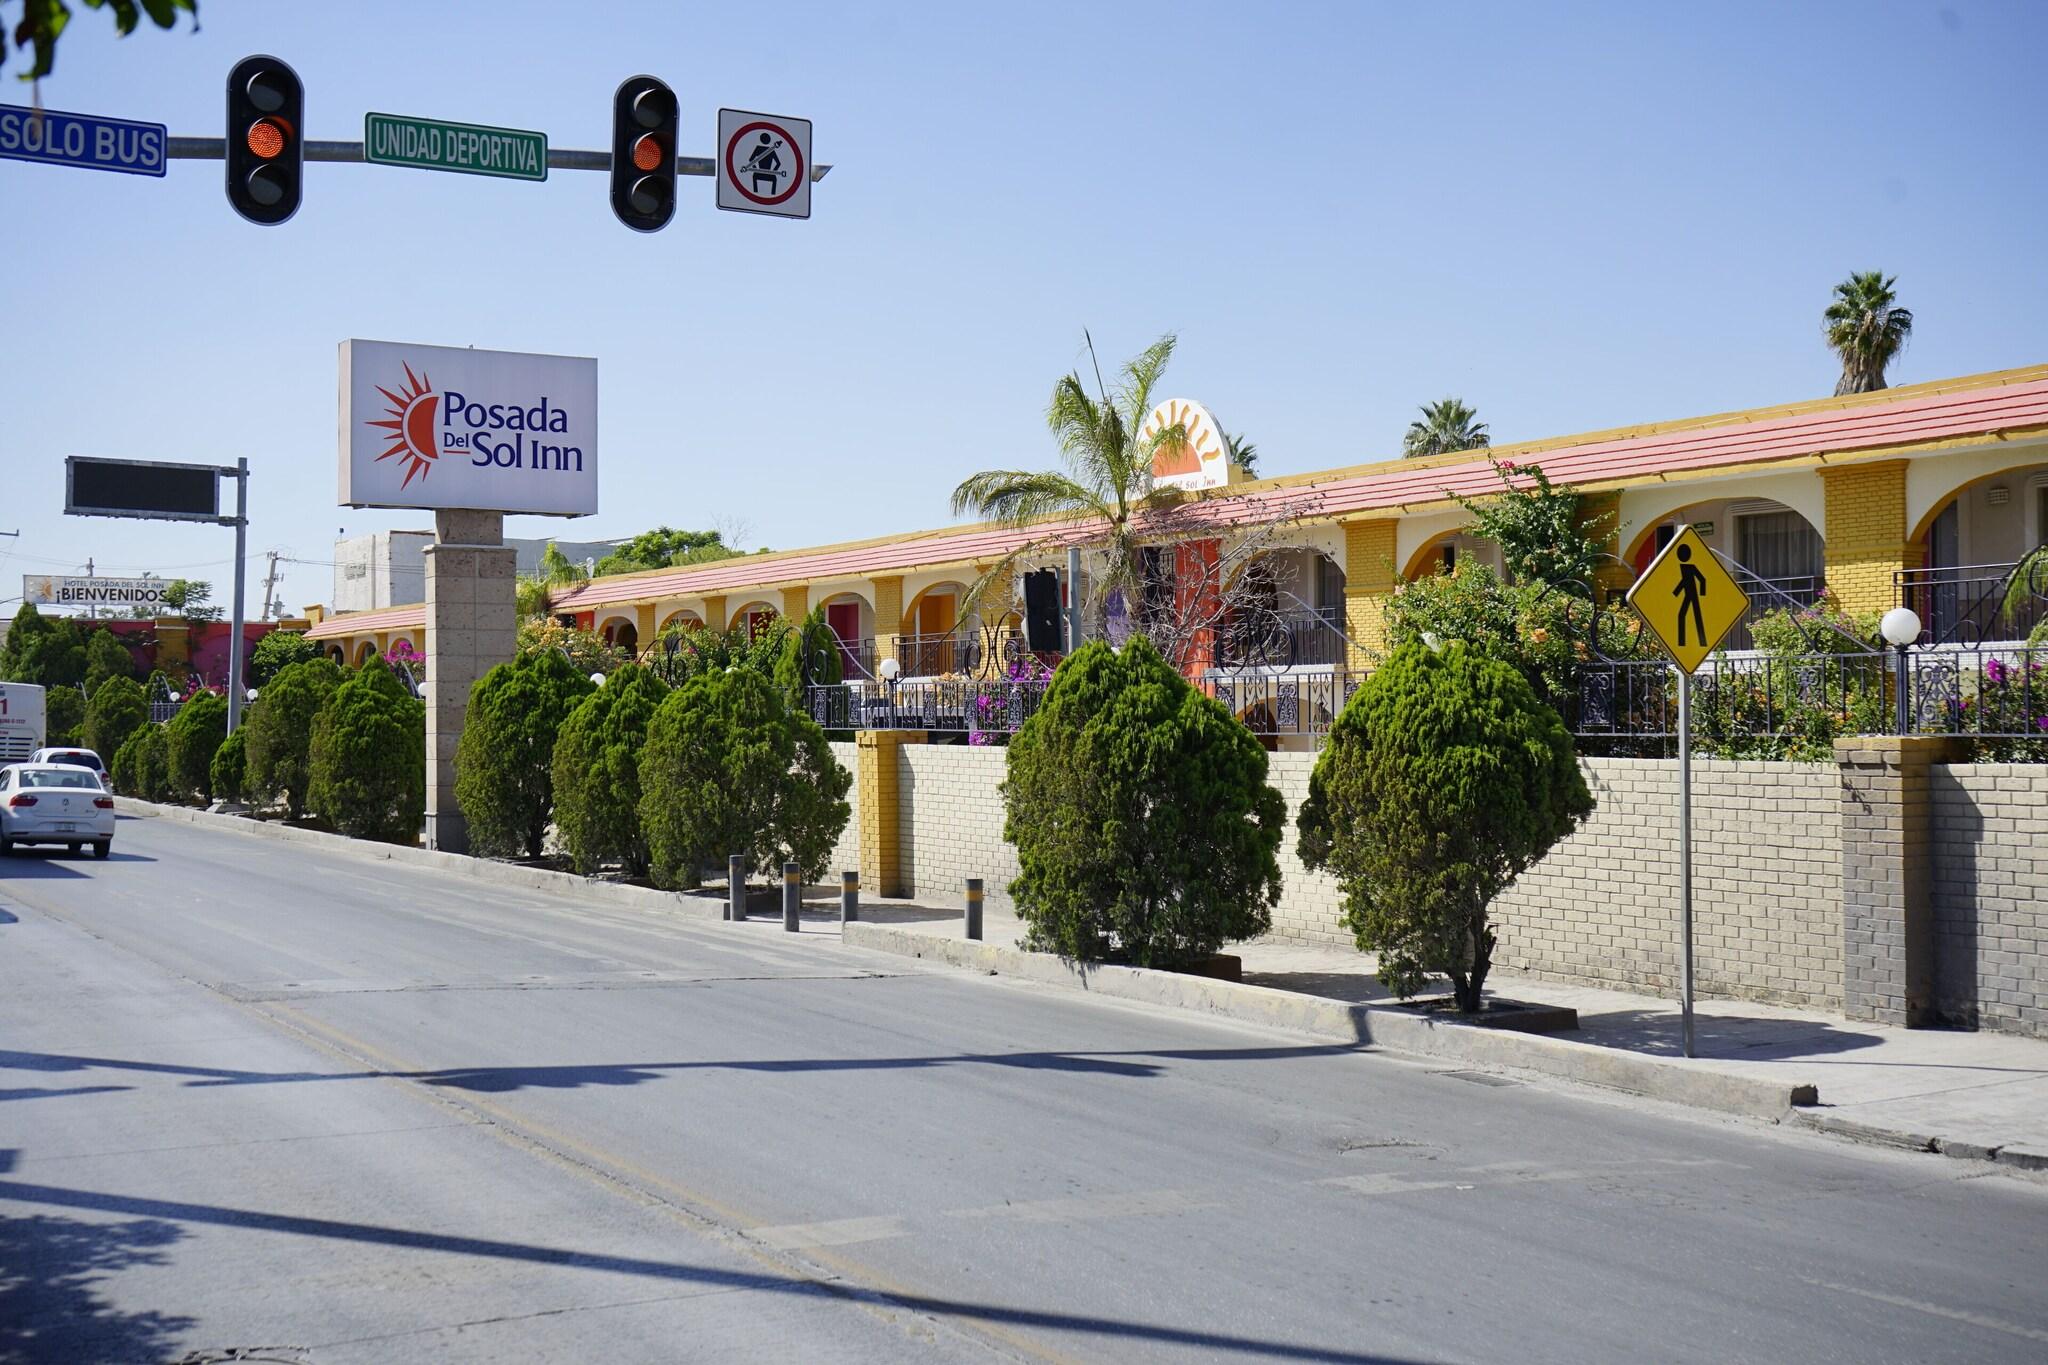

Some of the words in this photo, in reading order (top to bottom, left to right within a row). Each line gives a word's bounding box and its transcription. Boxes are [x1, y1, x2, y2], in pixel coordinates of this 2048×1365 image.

[0, 113, 85, 157] SOLO
[95, 126, 161, 167] BUS
[375, 122, 441, 160] UNIDAD
[446, 130, 539, 173] DEPORTIVA
[443, 391, 568, 433] Posada
[443, 432, 469, 448] Del
[472, 431, 522, 469] Sol
[531, 440, 583, 471] Inn
[64, 580, 87, 588] HOTEL
[150, 582, 165, 590] INN
